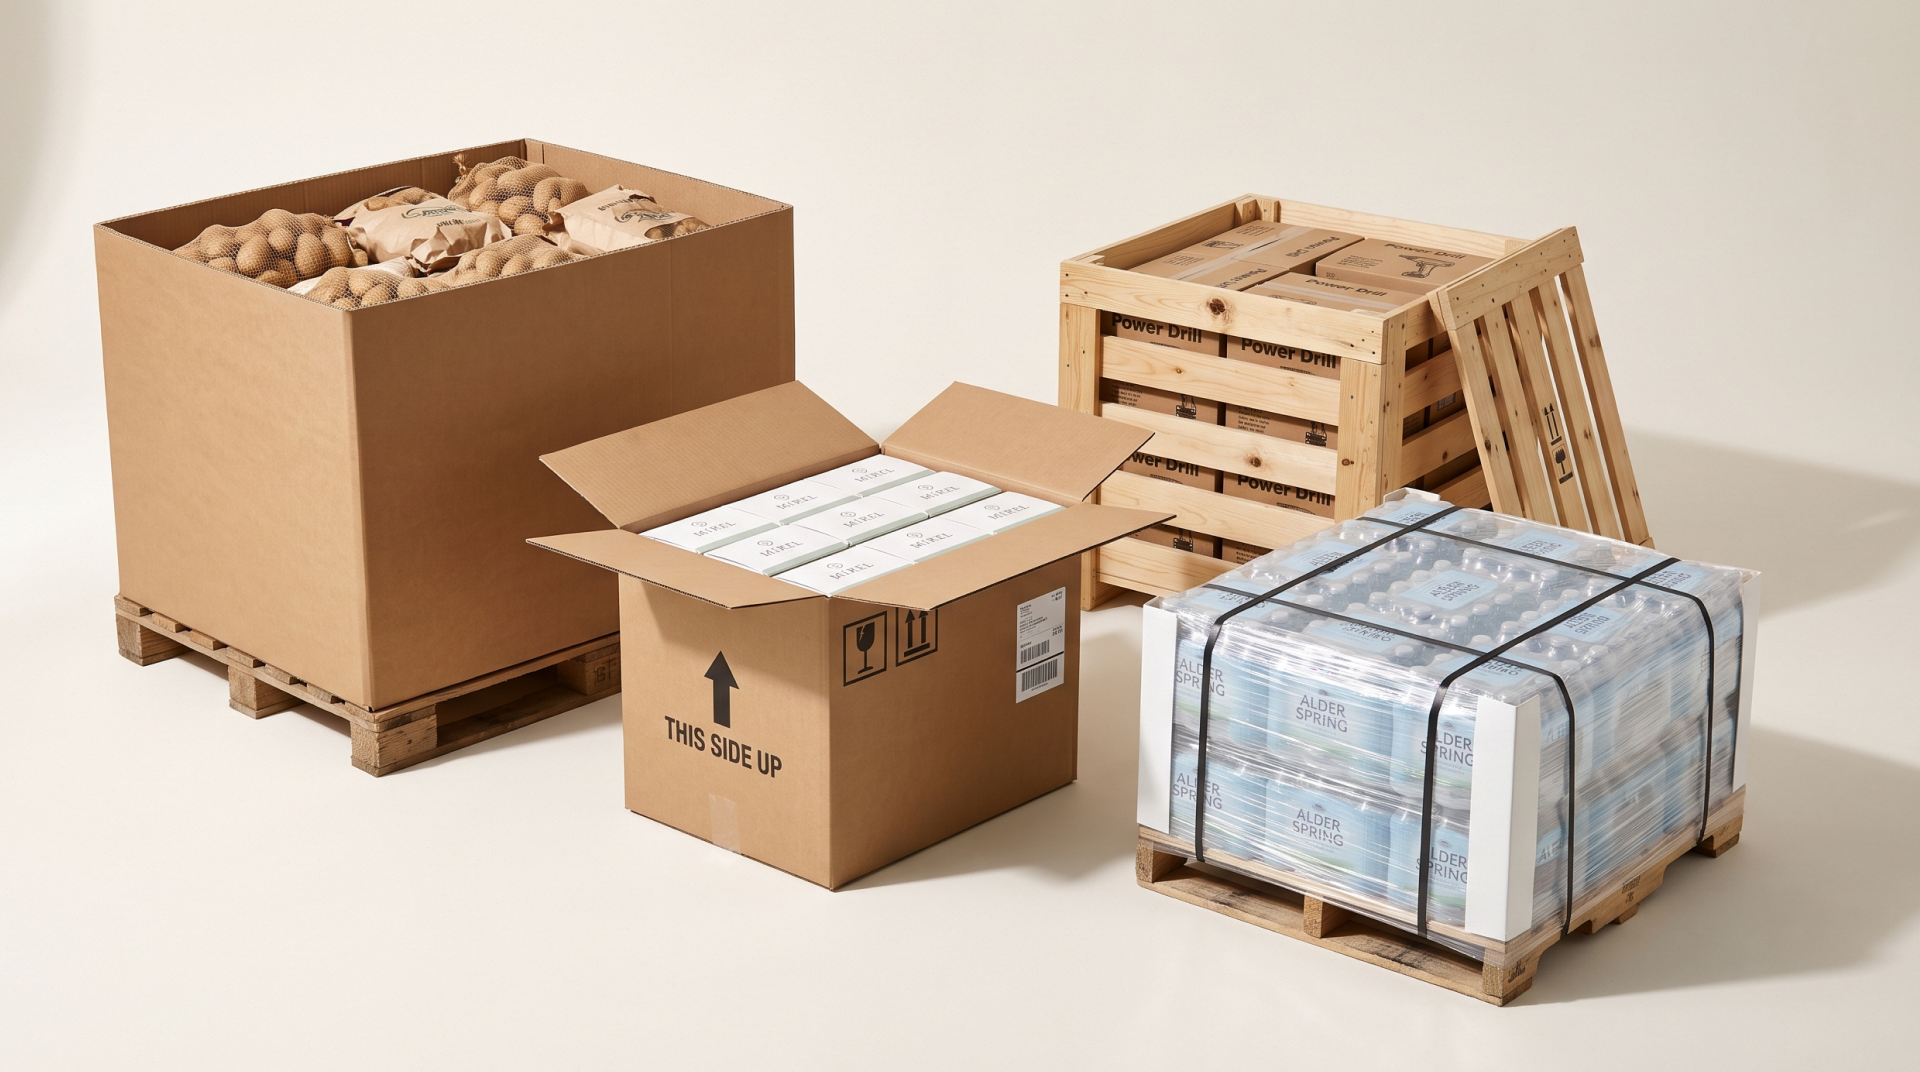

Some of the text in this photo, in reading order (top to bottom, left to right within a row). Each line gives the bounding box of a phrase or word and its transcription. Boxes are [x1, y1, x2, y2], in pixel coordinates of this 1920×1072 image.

[1384, 243, 1467, 260] Power Drill
[1305, 279, 1388, 297] Power Drill
[1112, 312, 1202, 343] Power Drill
[1241, 338, 1337, 369] Power Drill
[1166, 458, 1199, 477] Drill
[1237, 474, 1331, 506] Power Drill
[829, 563, 874, 580] MIREL
[1176, 670, 1225, 697] SPRNG
[1300, 694, 1346, 718] ALDER
[1296, 706, 1348, 732] SPRING
[664, 715, 782, 778] THIS SIDE UP
[1435, 731, 1473, 752] LDER
[1172, 784, 1222, 810] SPRNG
[1296, 808, 1341, 832] ALDER
[1292, 820, 1344, 847] SPRING
[1430, 846, 1468, 870] LDER
